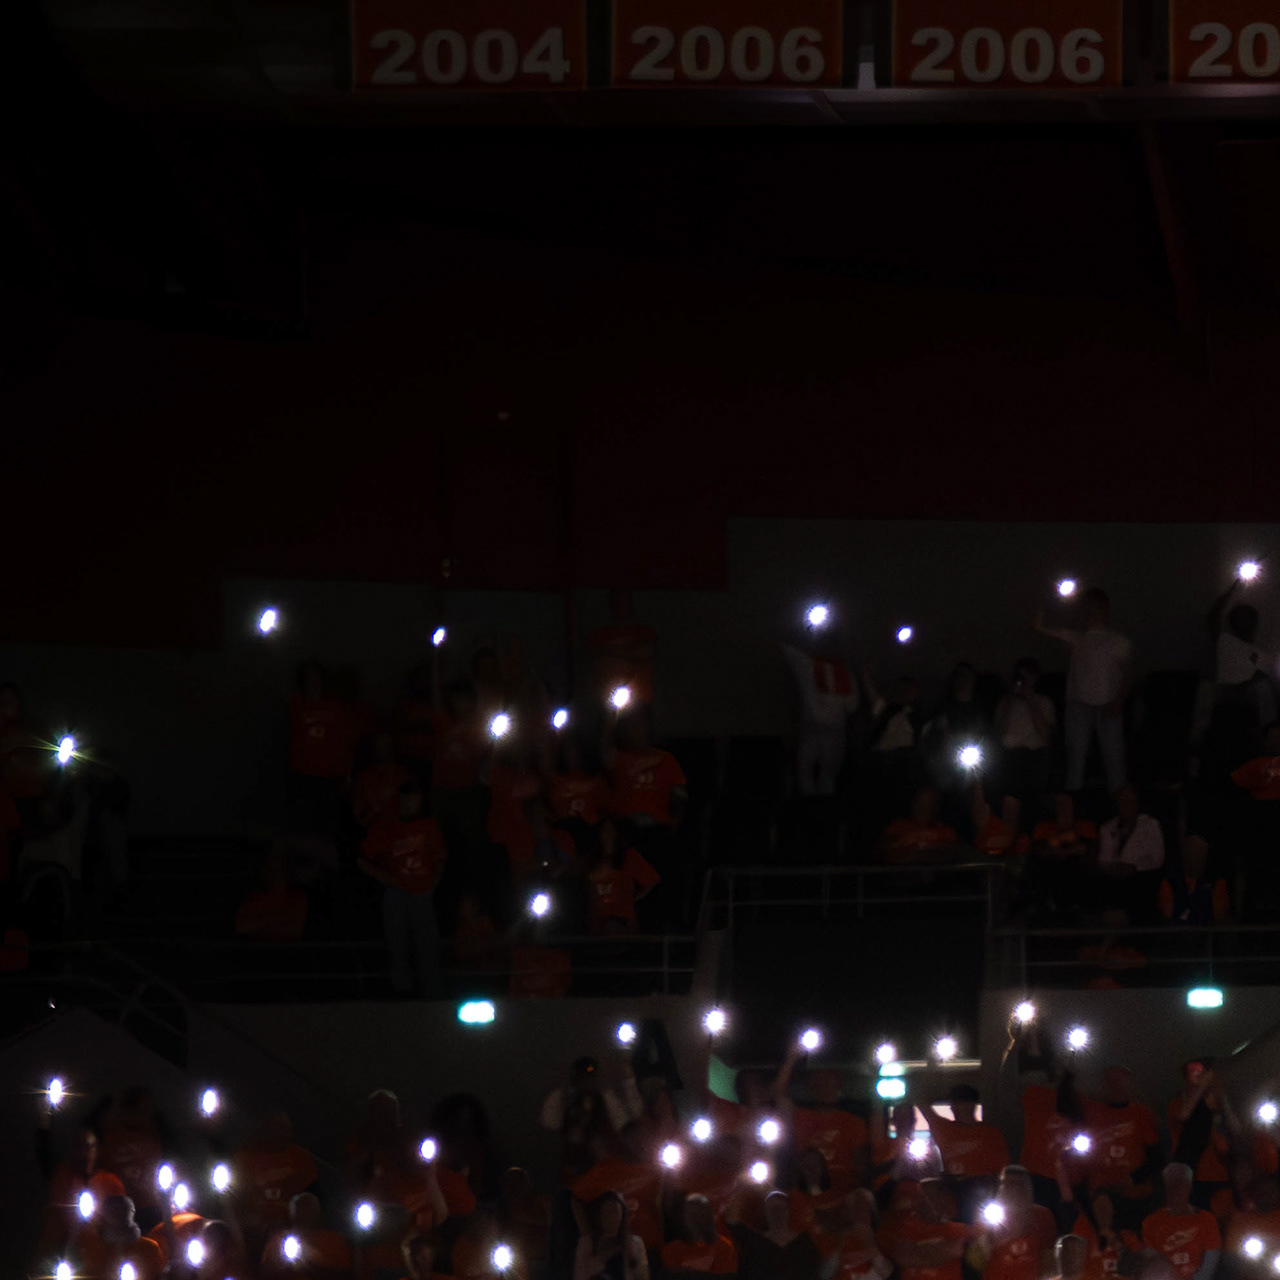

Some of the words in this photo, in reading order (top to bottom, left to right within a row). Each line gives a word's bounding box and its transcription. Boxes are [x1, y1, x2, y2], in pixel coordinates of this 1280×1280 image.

[371, 26, 571, 84] 2004
[629, 25, 825, 81] 2006
[910, 26, 1105, 83] 2006
